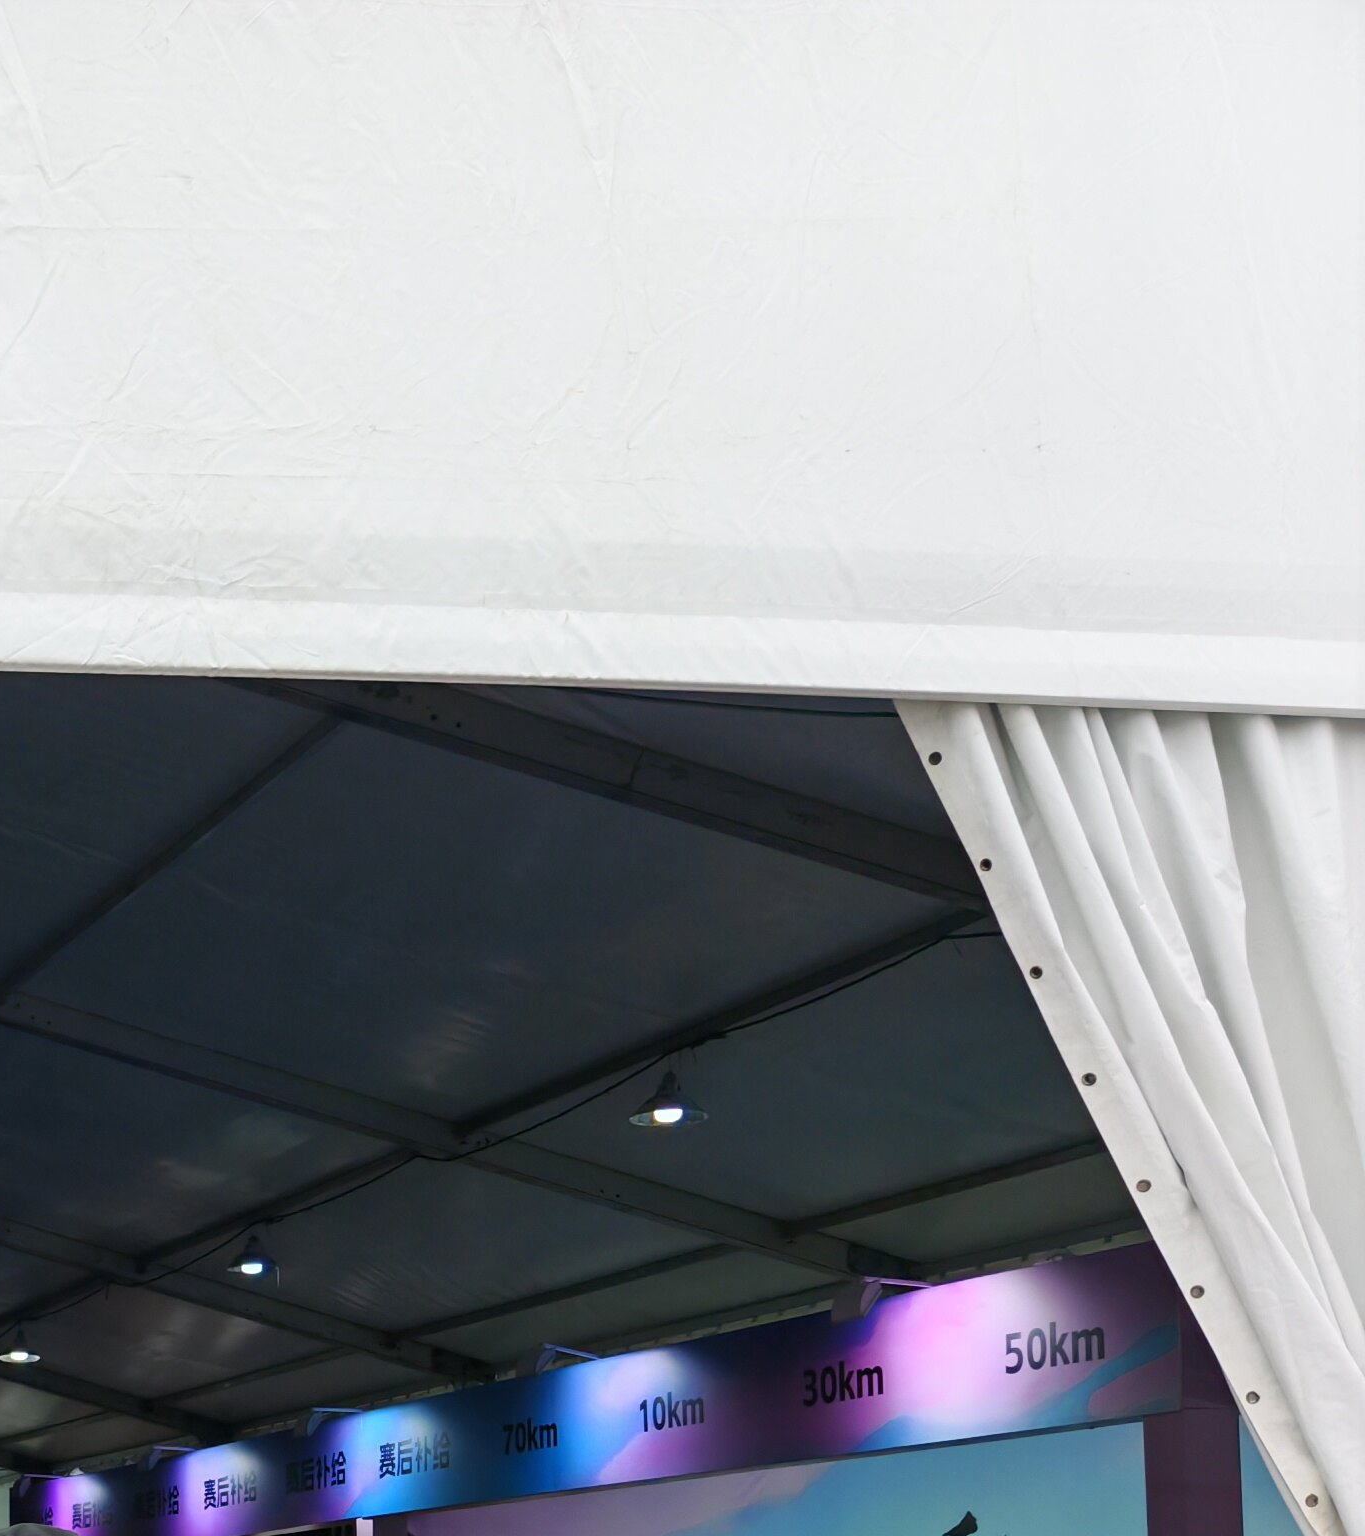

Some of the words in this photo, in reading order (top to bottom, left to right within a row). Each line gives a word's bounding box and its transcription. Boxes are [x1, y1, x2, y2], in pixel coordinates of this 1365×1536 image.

[1004, 1321, 1106, 1376] 50km
[802, 1360, 885, 1407] 30km
[639, 1391, 705, 1433] 10km
[378, 1431, 452, 1479] 赛后补给
[502, 1417, 558, 1455] 70km
[203, 1470, 257, 1510] 赛后补给
